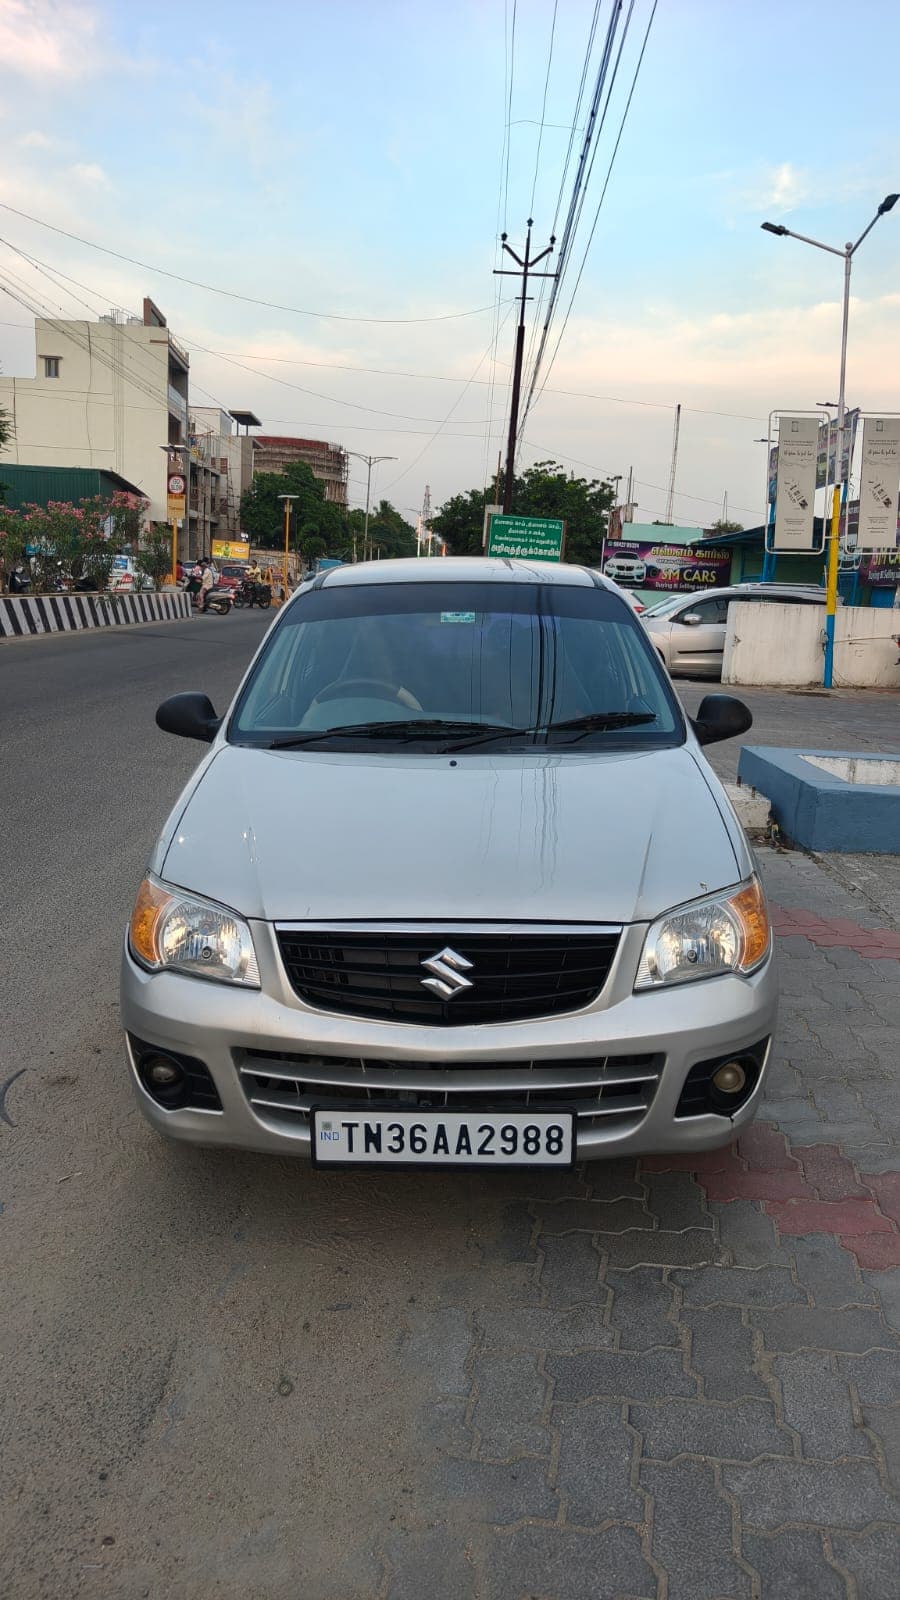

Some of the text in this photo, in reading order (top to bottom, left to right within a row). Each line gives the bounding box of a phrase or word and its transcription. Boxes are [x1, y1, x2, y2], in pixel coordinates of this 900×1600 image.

[661, 567, 717, 582] SM CARS
[320, 1122, 564, 1156] IND TN36AA2988
